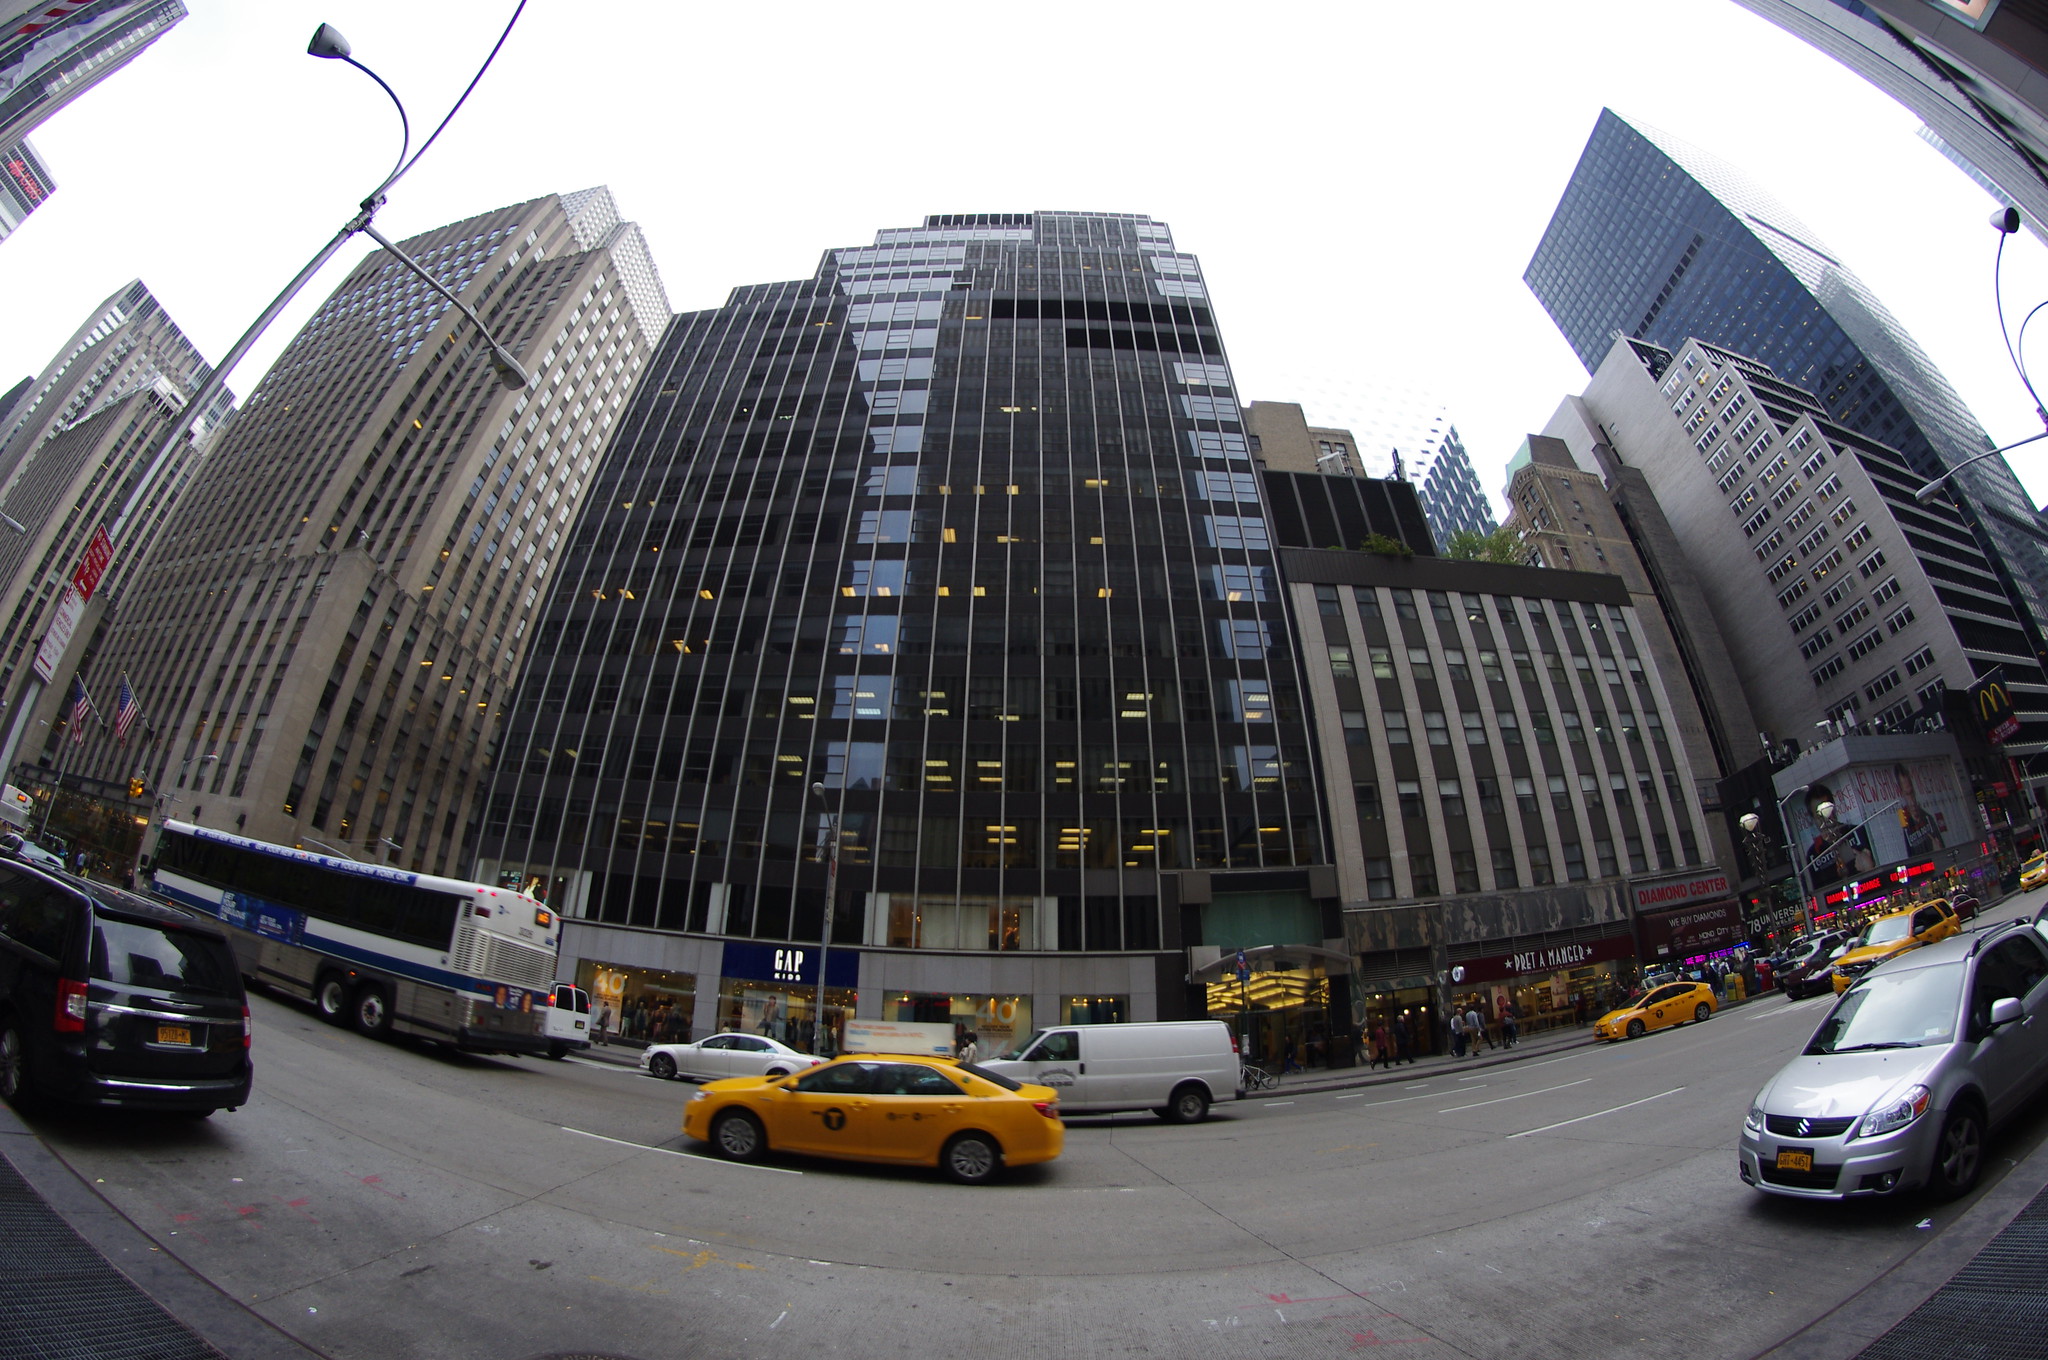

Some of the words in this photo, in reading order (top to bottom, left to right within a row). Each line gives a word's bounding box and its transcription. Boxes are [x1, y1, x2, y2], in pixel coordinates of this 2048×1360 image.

[1638, 883, 1687, 905] DIAMOND
[1689, 877, 1728, 896] CENTER
[1668, 918, 1680, 928] WE
[1680, 915, 1693, 926] BUY
[1693, 909, 1727, 923] DIAMONDS
[1747, 918, 1762, 935] 78
[1760, 904, 1803, 925] UNVERSAL
[774, 949, 804, 973] GAP
[1514, 951, 1535, 972] PRET
[1539, 952, 1546, 967] A
[1548, 944, 1585, 966] MANGER
[594, 970, 625, 994] 40
[774, 972, 801, 982] KIDS
[976, 1000, 1017, 1024] 40
